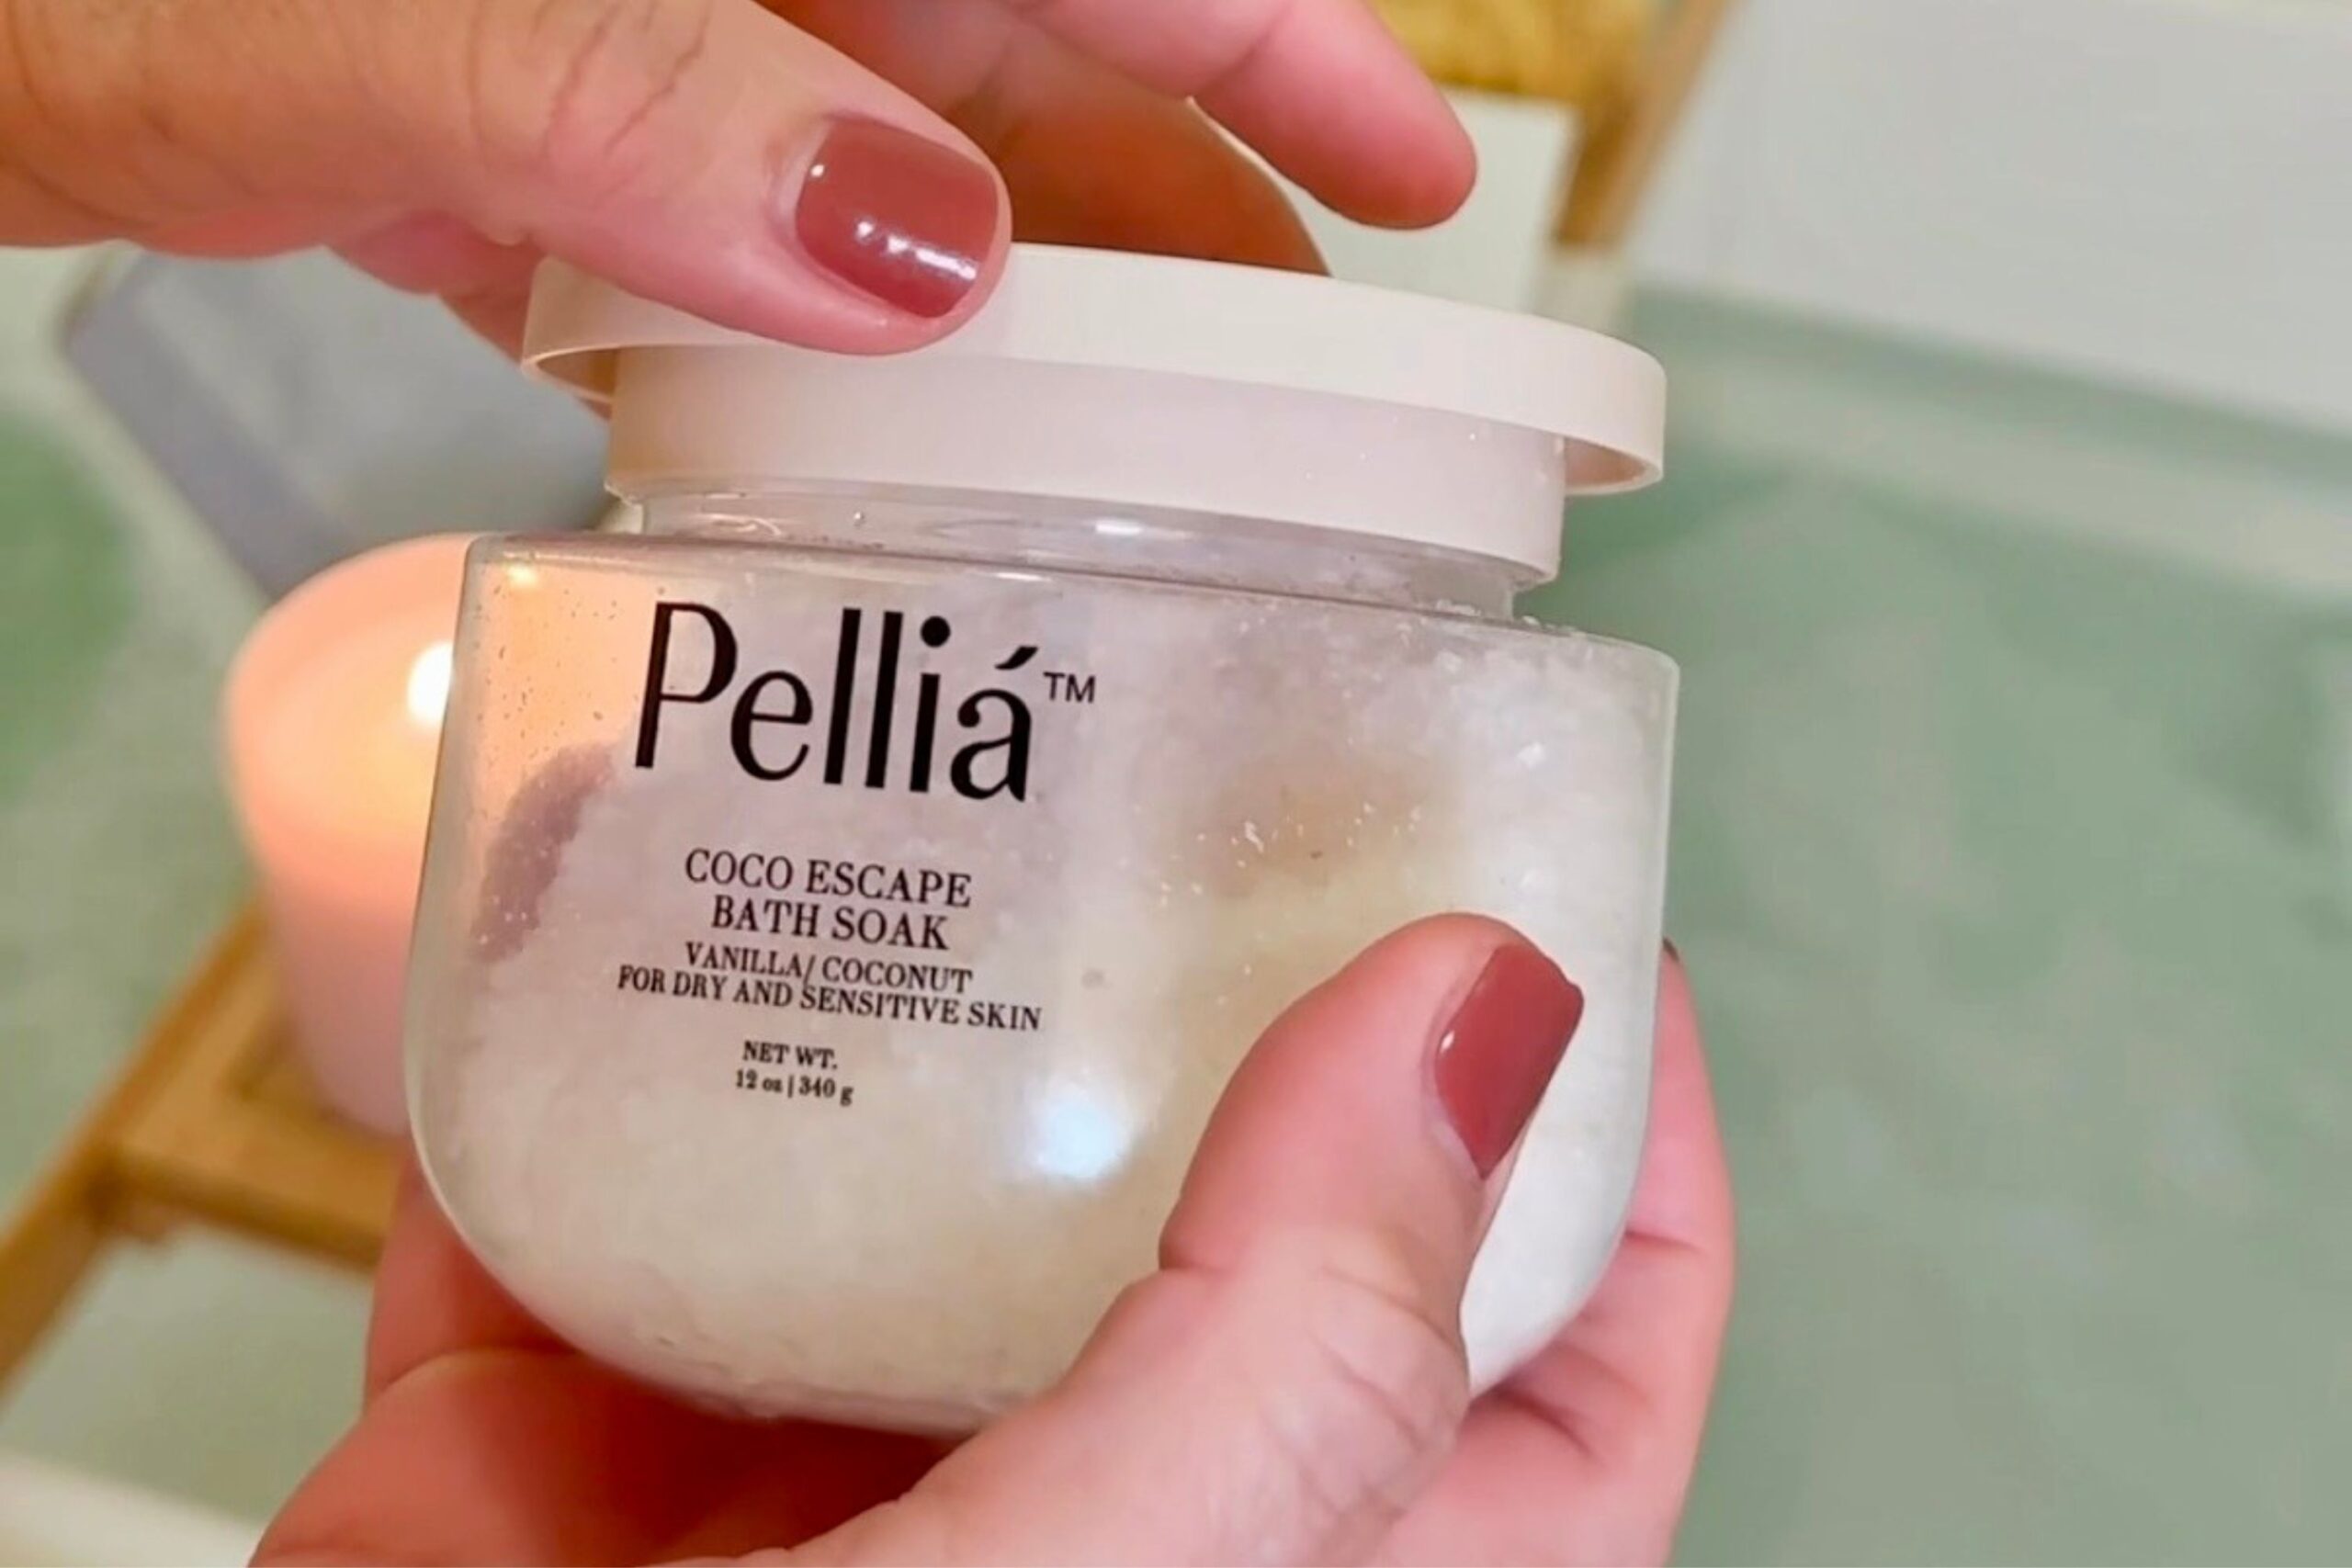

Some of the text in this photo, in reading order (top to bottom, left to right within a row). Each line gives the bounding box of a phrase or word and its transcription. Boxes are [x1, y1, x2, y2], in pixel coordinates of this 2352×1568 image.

[635, 602, 1039, 802] Pelliá
[684, 848, 972, 908] COCO ESCAPE
[711, 895, 949, 951] BATH SOAK
[617, 964, 1042, 1031] FOR DRY AND SENSITIVE SKIN
[821, 955, 973, 993] COCONUT
[742, 1040, 839, 1069] NET WT.
[736, 1069, 758, 1089] 12
[798, 1075, 836, 1098] 340
[840, 1086, 854, 1107] g
